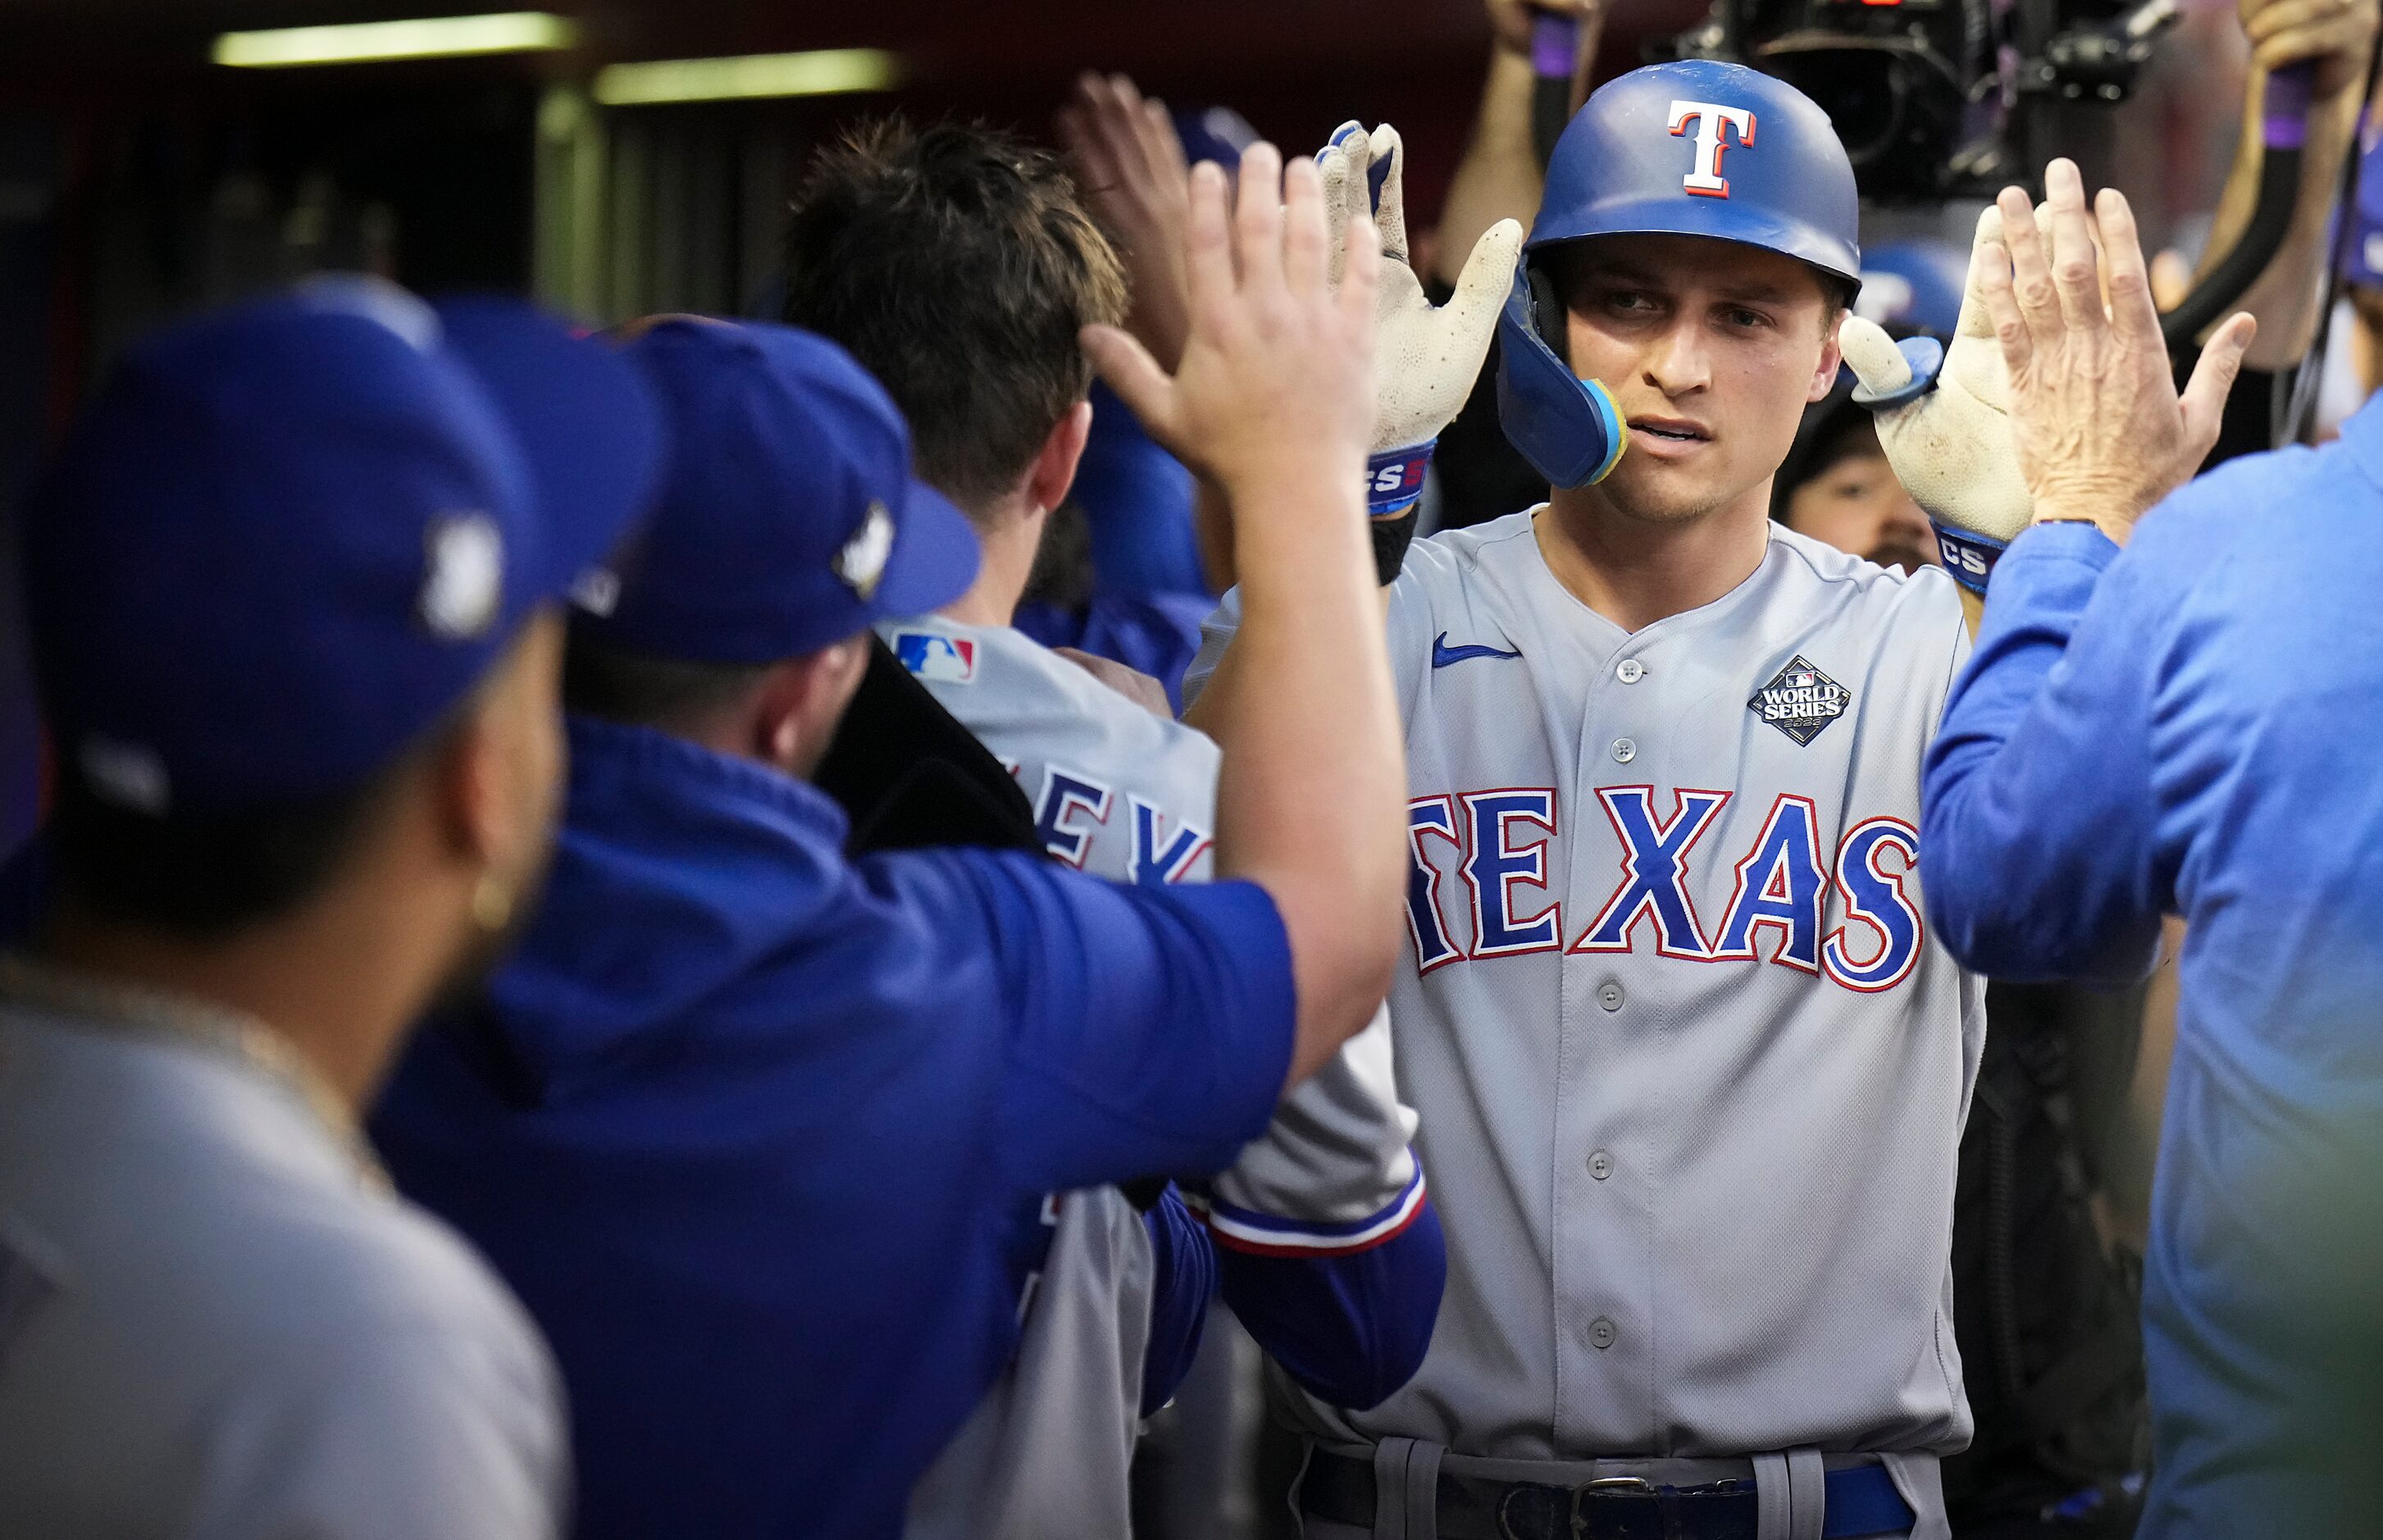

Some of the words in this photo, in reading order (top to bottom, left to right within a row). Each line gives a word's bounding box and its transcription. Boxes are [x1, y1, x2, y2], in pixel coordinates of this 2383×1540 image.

[1667, 100, 1756, 199] T
[1762, 686, 1839, 704] WORLD
[1764, 700, 1841, 720] SERIES
[1784, 718, 1821, 727] 2023
